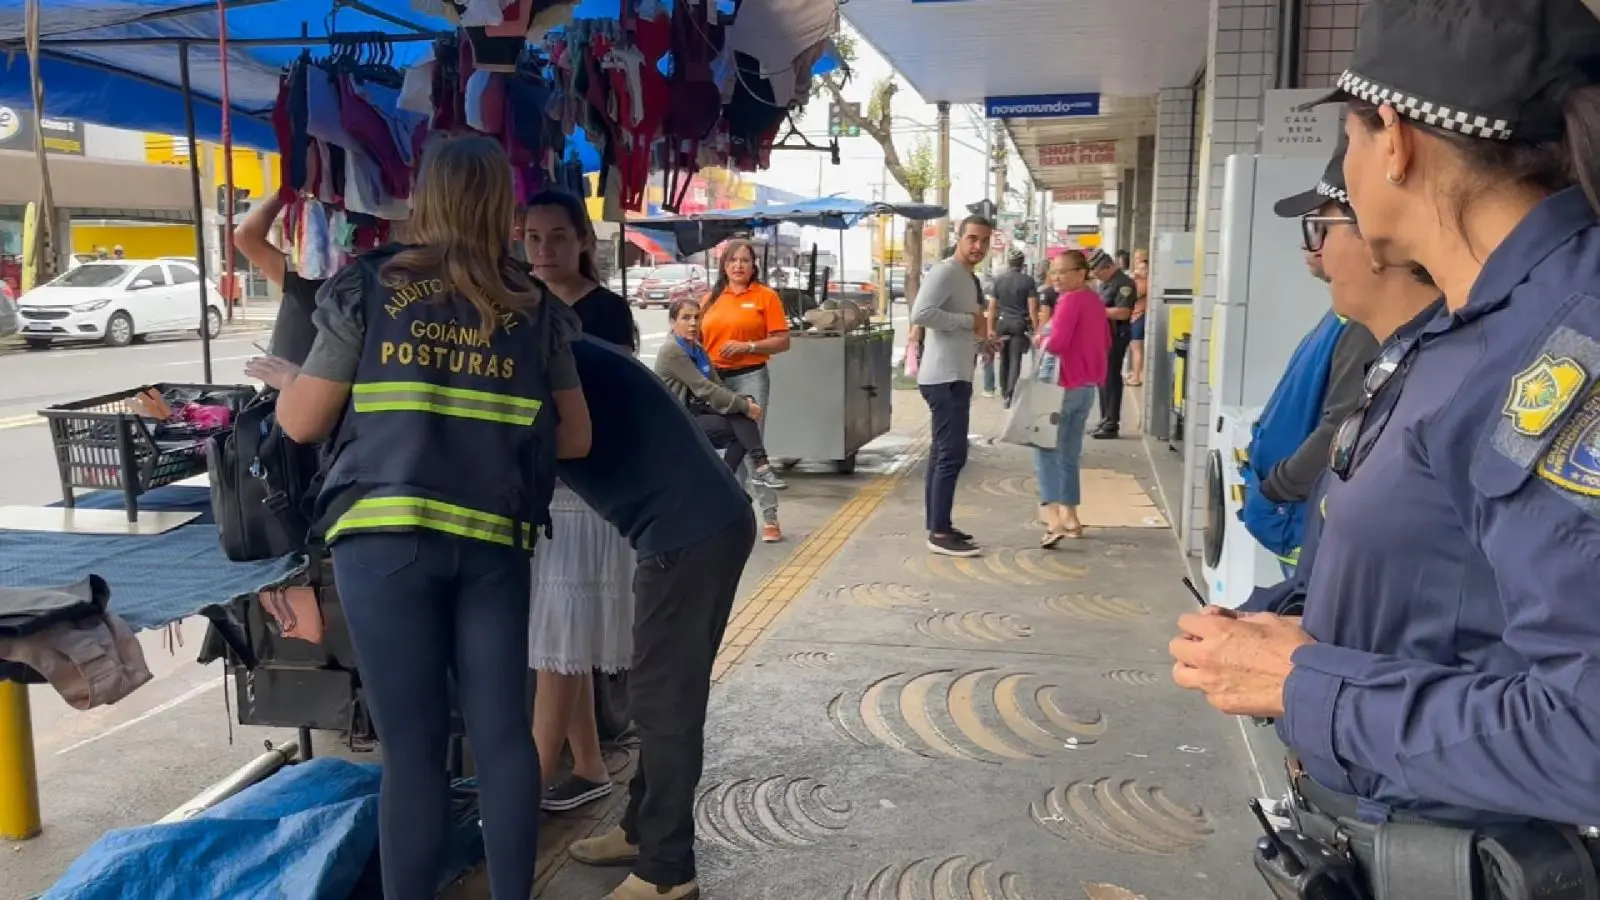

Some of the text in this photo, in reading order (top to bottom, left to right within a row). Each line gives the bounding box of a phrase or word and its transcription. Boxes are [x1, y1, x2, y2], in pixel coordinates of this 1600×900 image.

[1284, 116, 1318, 124] CASA
[410, 318, 492, 348] GOIÂNIA
[381, 341, 515, 380] POSTURAS
